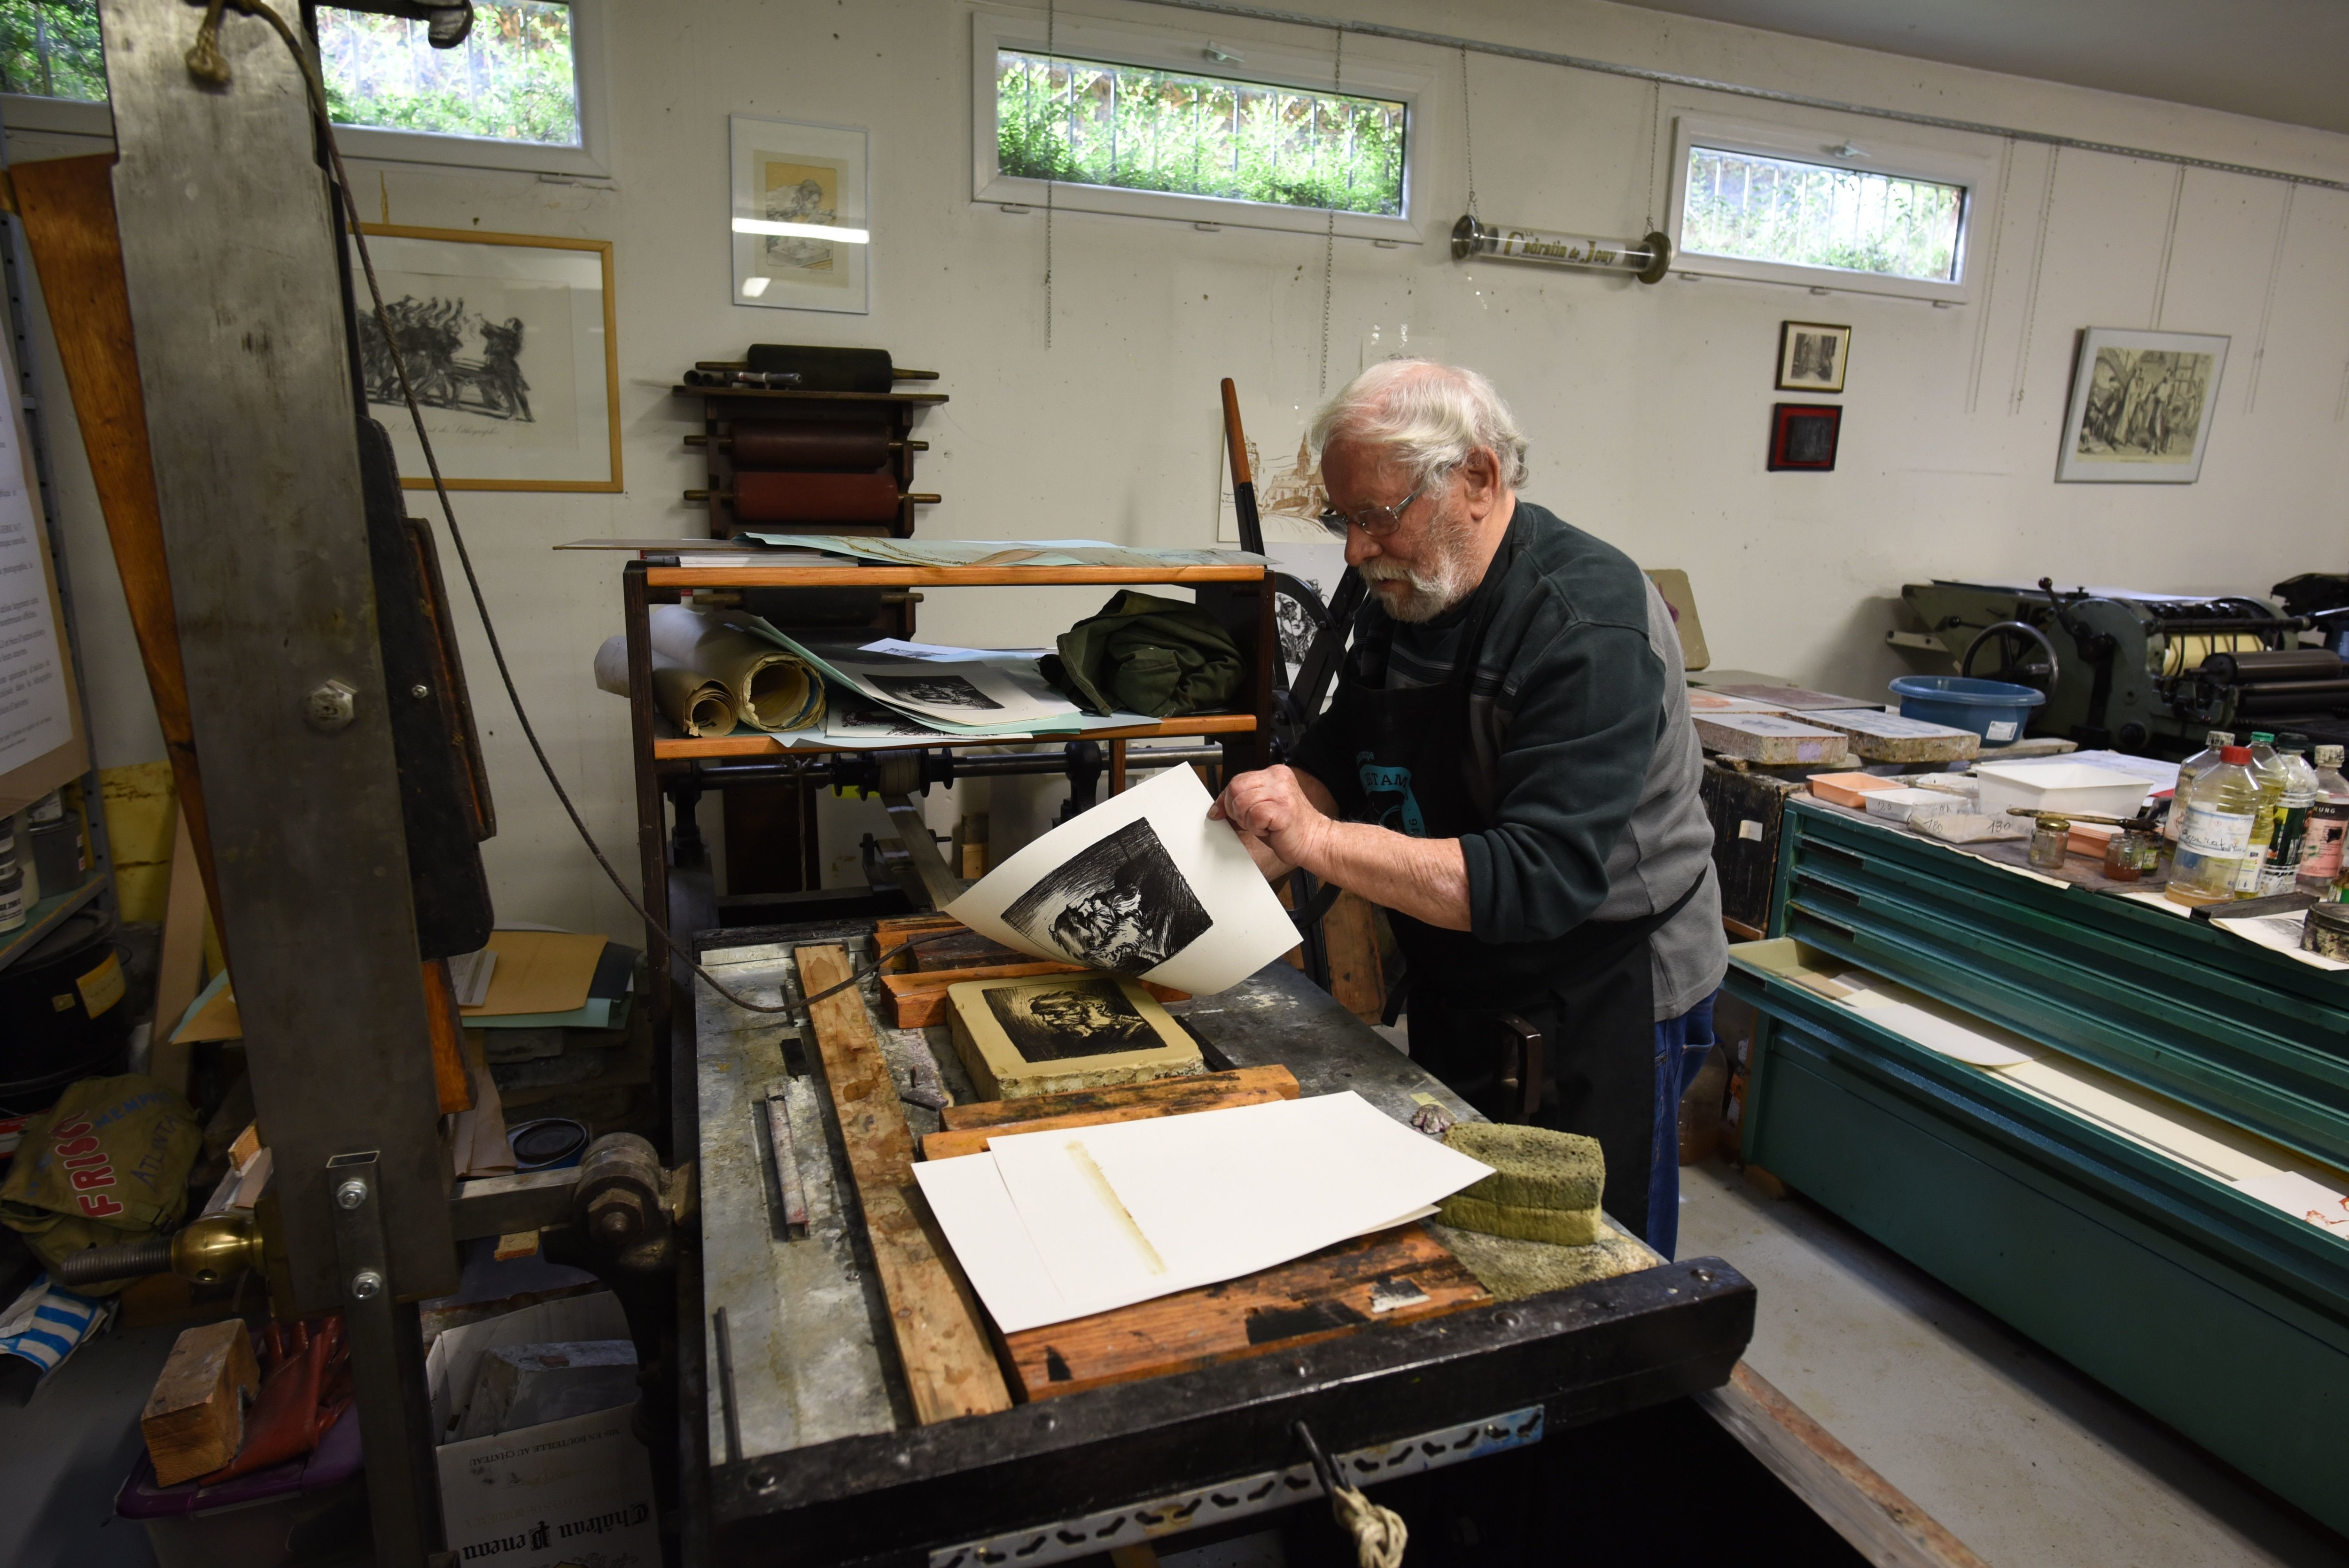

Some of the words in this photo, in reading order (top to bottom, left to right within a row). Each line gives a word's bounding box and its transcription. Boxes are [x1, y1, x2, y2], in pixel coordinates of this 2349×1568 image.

[1579, 240, 1617, 265] Jouy
[1987, 820, 2011, 834] 180
[533, 1435, 586, 1453] BOUTEILLE
[588, 1431, 602, 1443] EN
[516, 1446, 530, 1458] AU
